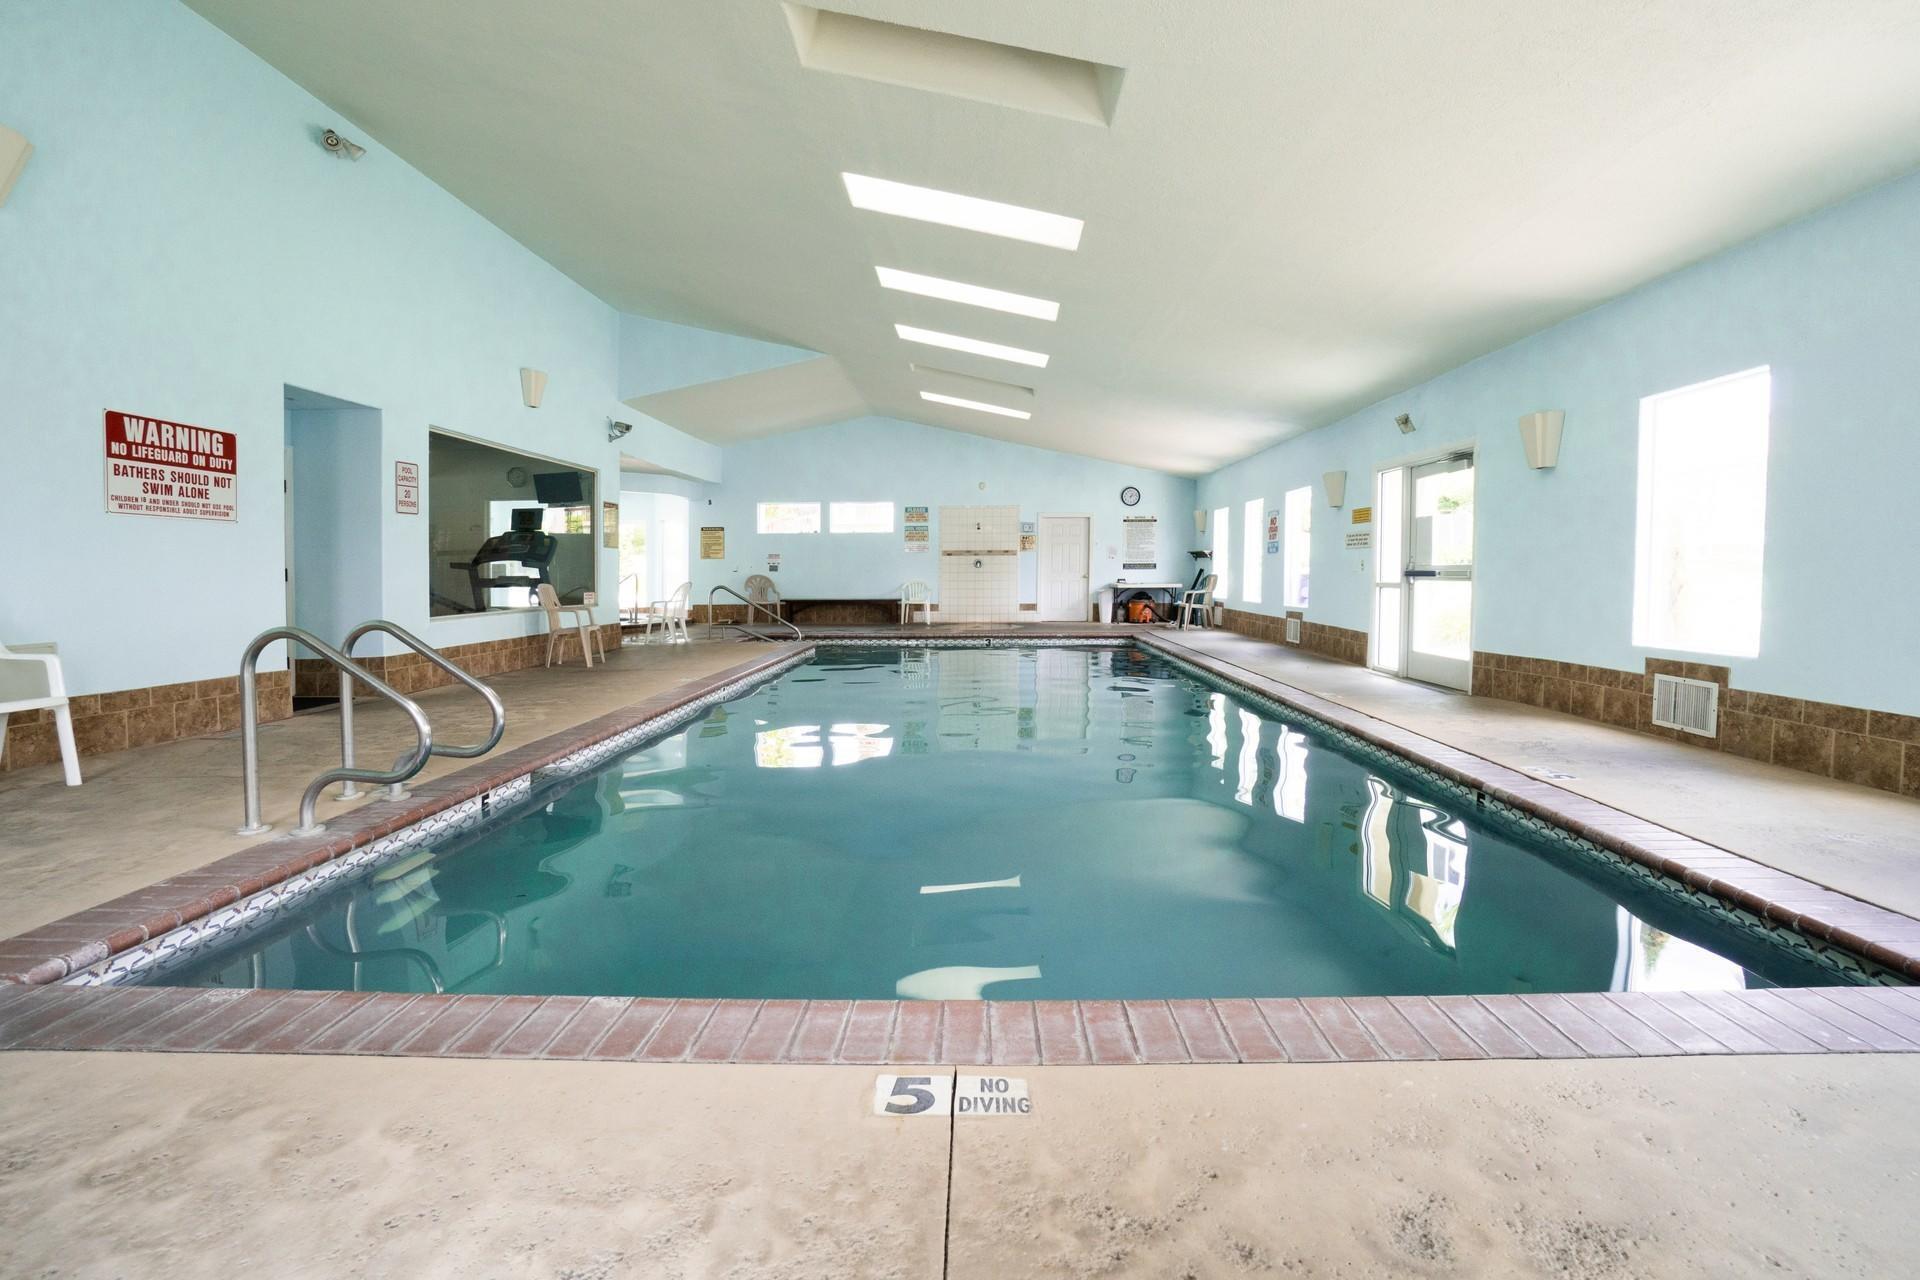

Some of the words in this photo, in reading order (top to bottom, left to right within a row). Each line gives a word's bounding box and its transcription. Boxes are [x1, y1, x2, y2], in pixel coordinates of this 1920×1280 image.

[123, 416, 224, 456] WARNING
[111, 442, 127, 456] NO
[132, 445, 189, 464] LIFEGUARD
[193, 455, 206, 467] ON
[210, 457, 233, 470] DUTY
[113, 464, 165, 481] BATHERS
[170, 471, 209, 486] SHOULD
[214, 476, 232, 489] NOT
[110, 495, 139, 503] CHILDREN
[142, 482, 173, 496] SWIM
[178, 487, 210, 500] ALONE
[118, 502, 143, 510] WITHOUT
[145, 504, 181, 513] RESPONSIBLE
[199, 509, 230, 517] SUPERVISION
[985, 638, 992, 647] 3
[980, 1078, 1009, 1093] NO
[884, 1077, 936, 1115] 5
[958, 1097, 1031, 1114] DIVING
